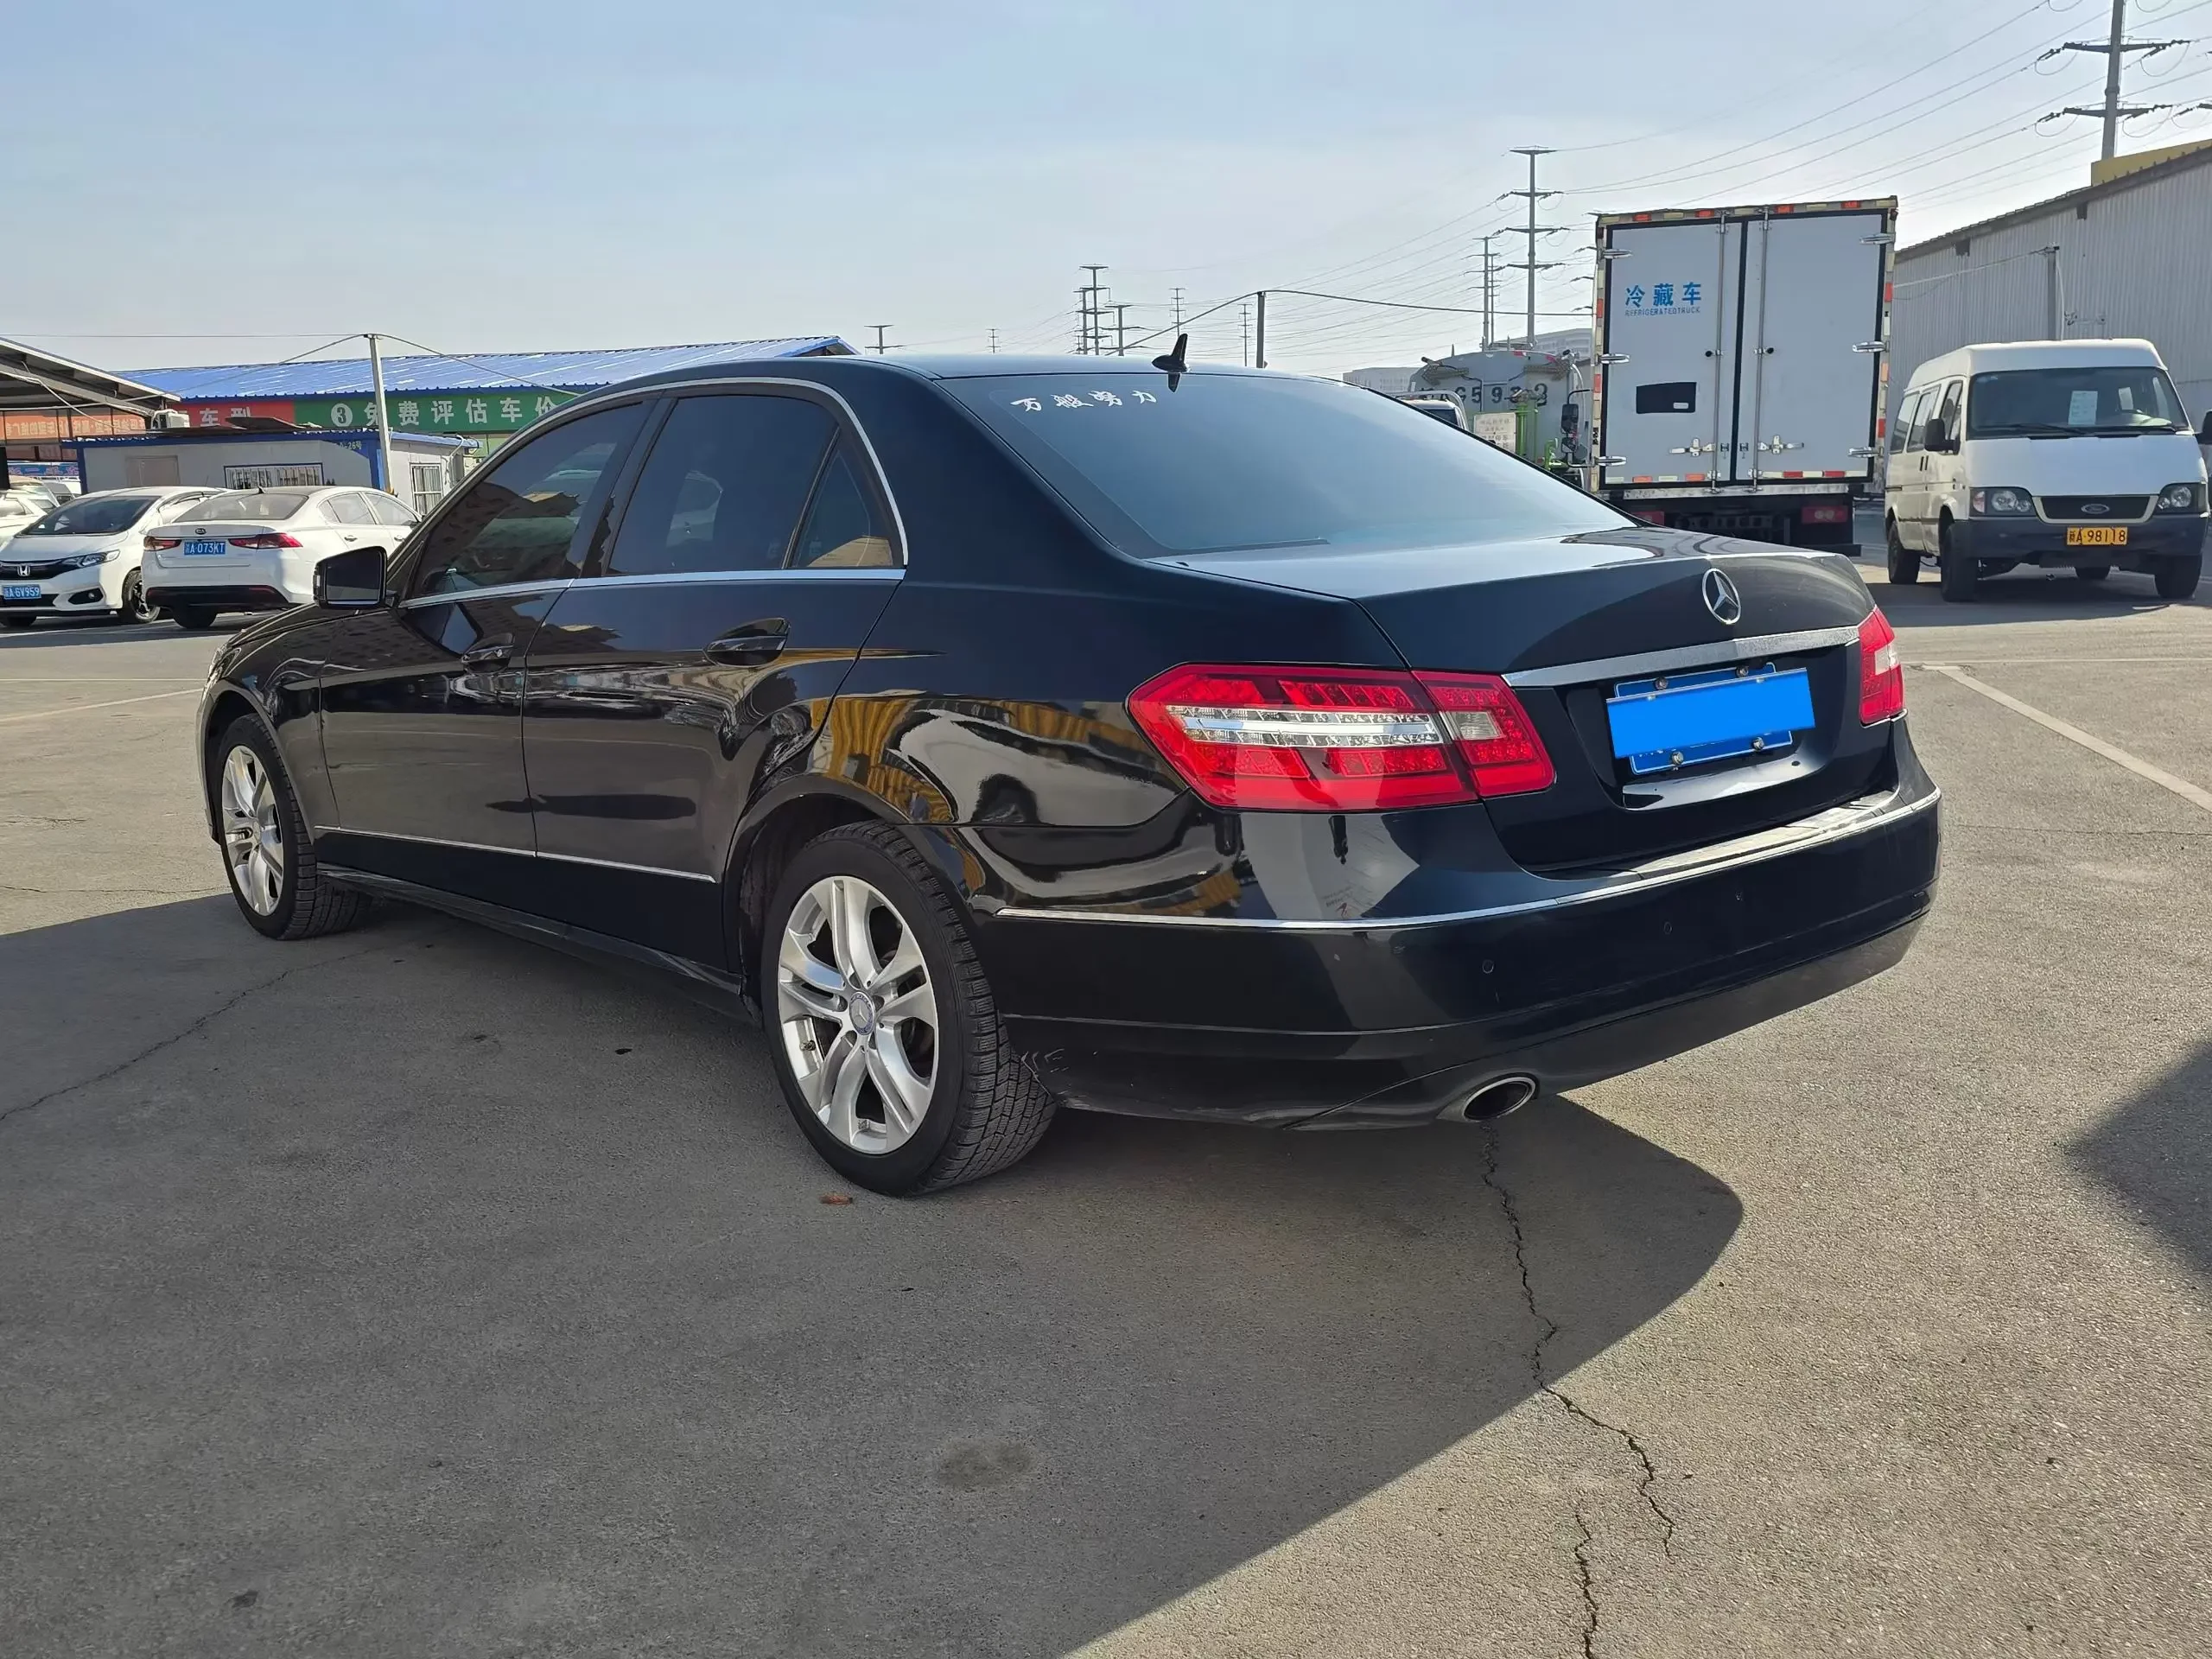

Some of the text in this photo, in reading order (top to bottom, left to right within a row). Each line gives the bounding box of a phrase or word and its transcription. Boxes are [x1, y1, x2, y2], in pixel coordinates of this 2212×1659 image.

[1624, 282, 1702, 308] 冷藏车
[1009, 390, 1157, 412] 万般努力
